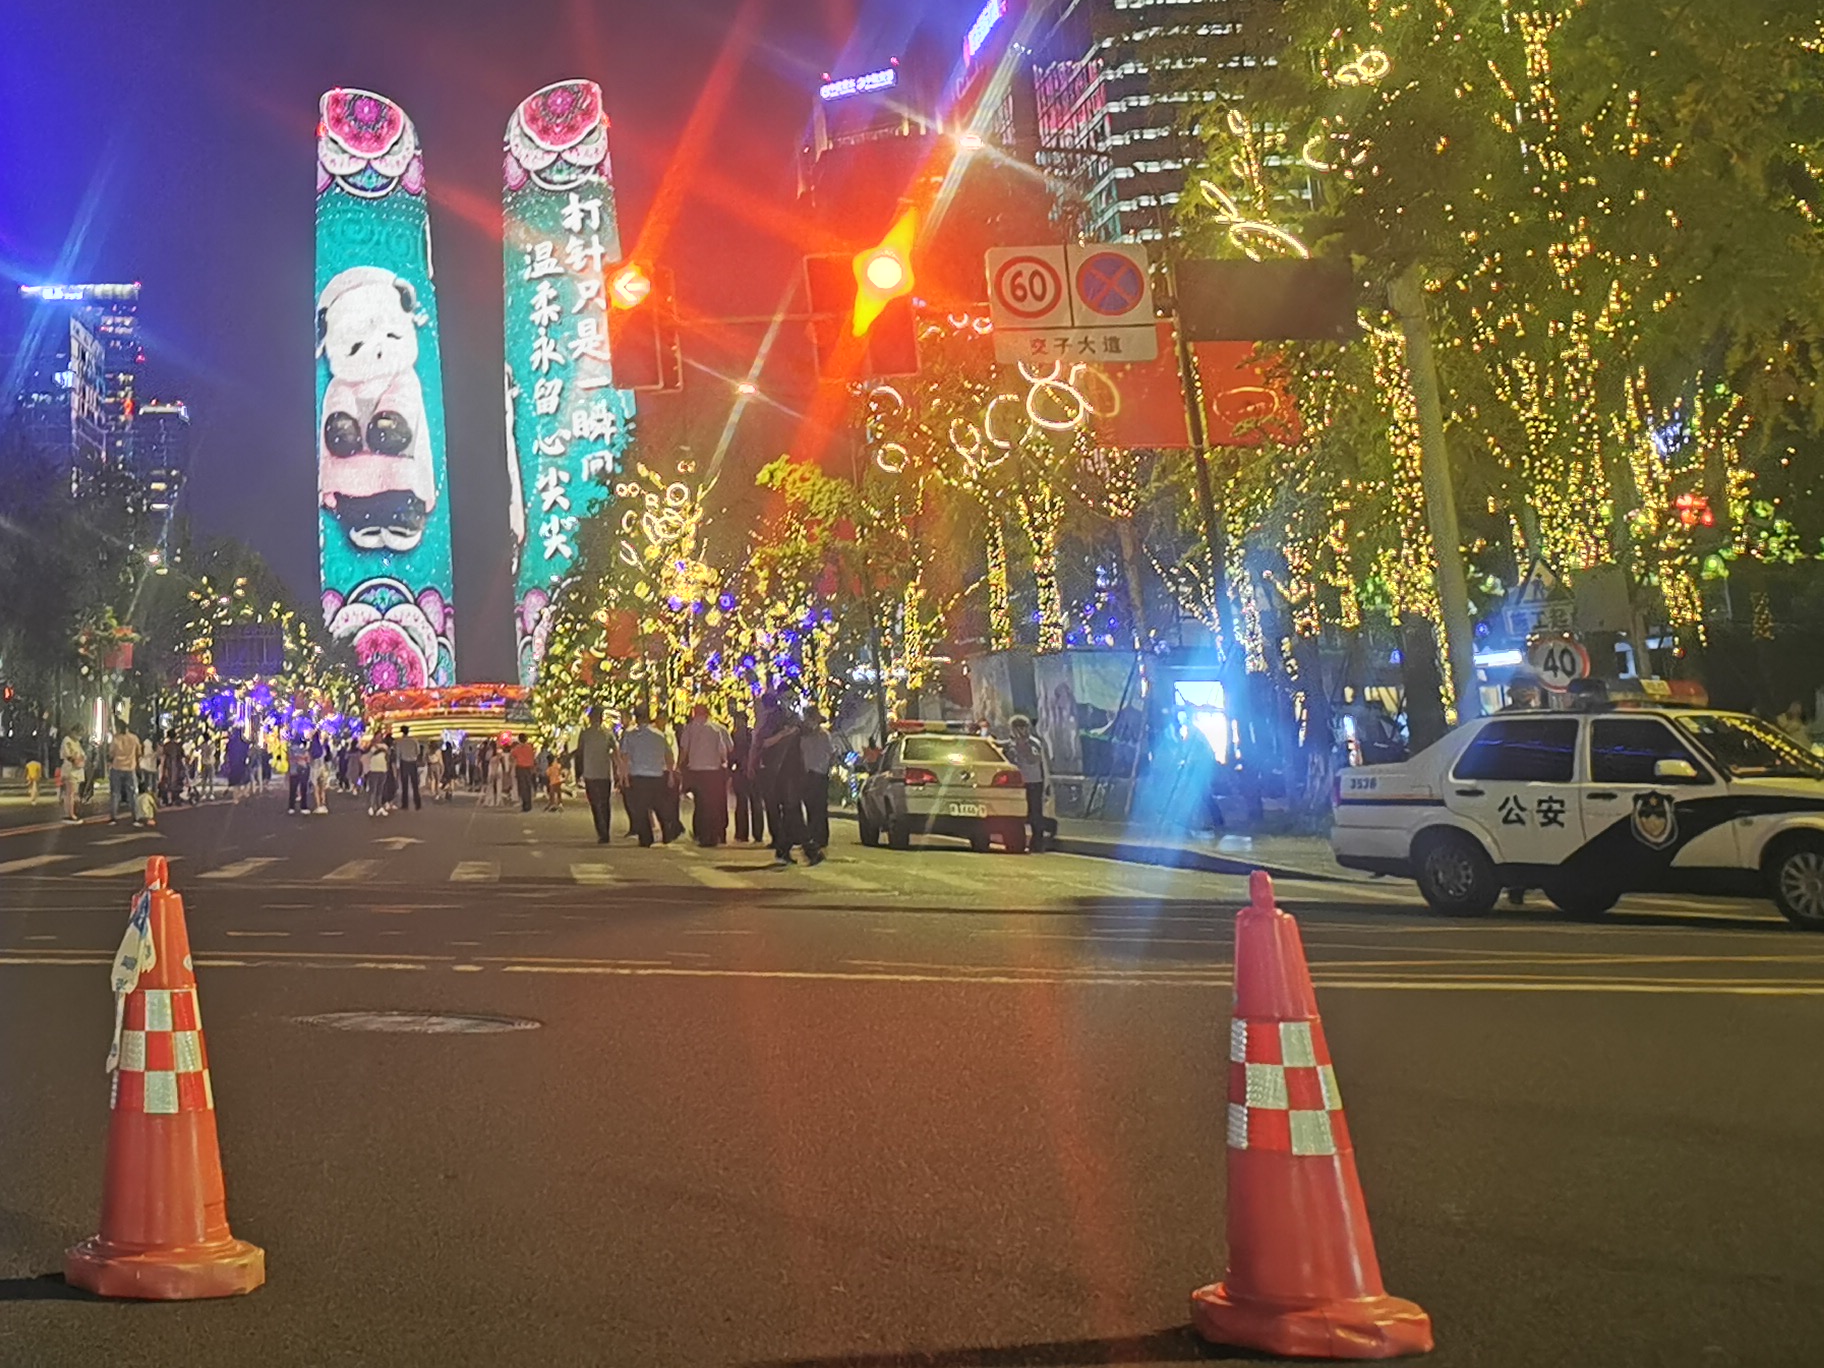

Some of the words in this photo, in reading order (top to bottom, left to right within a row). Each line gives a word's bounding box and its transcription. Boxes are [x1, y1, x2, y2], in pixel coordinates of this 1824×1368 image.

[1009, 268, 1047, 303] 60
[1029, 335, 1123, 356] 交子大道
[523, 241, 573, 561] 温柔永留心尖尖
[1542, 647, 1577, 678] 40
[1497, 794, 1566, 829] 公安
